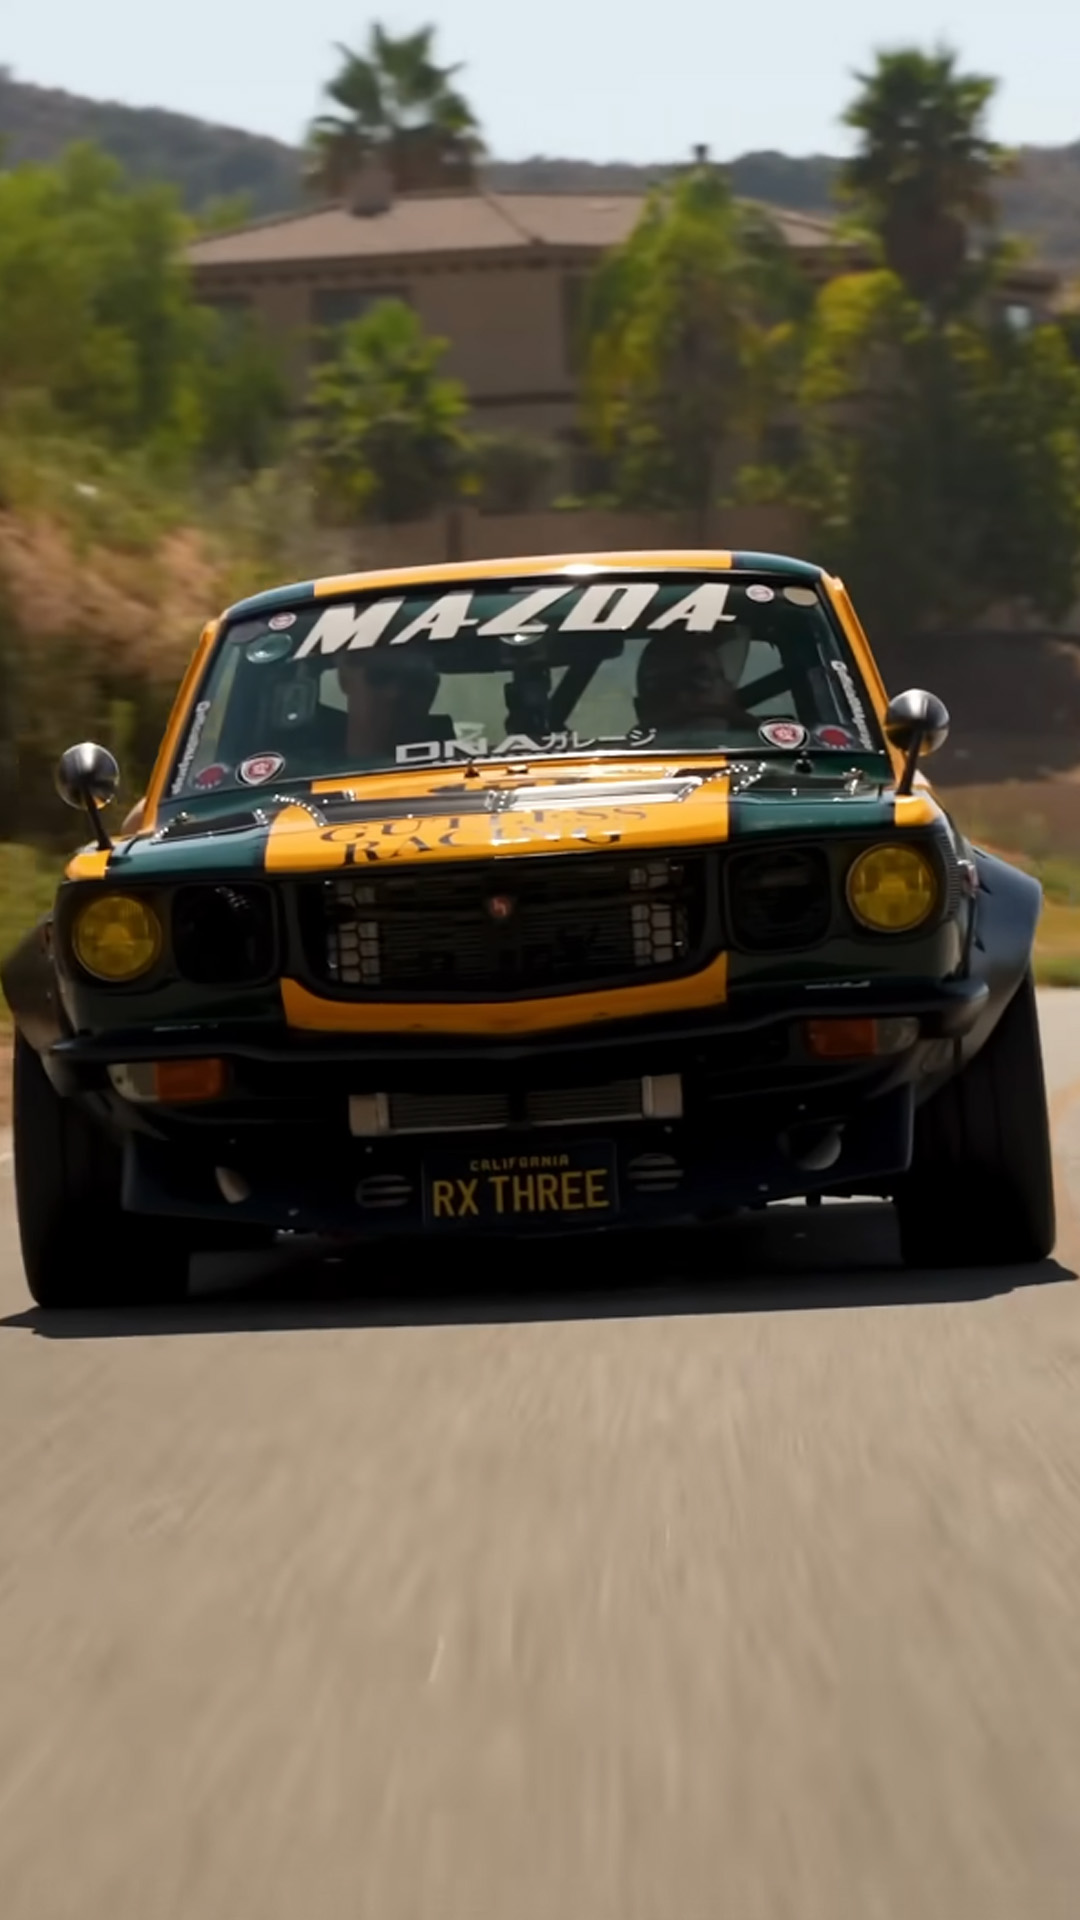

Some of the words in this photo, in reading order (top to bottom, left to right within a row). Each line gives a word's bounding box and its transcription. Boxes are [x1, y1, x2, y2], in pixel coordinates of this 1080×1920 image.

[293, 583, 736, 659] MAZDA
[396, 734, 543, 764] DNA
[542, 728, 657, 749] ガレージ
[469, 1154, 569, 1172] CALIFORNIA
[433, 1178, 480, 1217] RX
[488, 1169, 610, 1214] THREE
